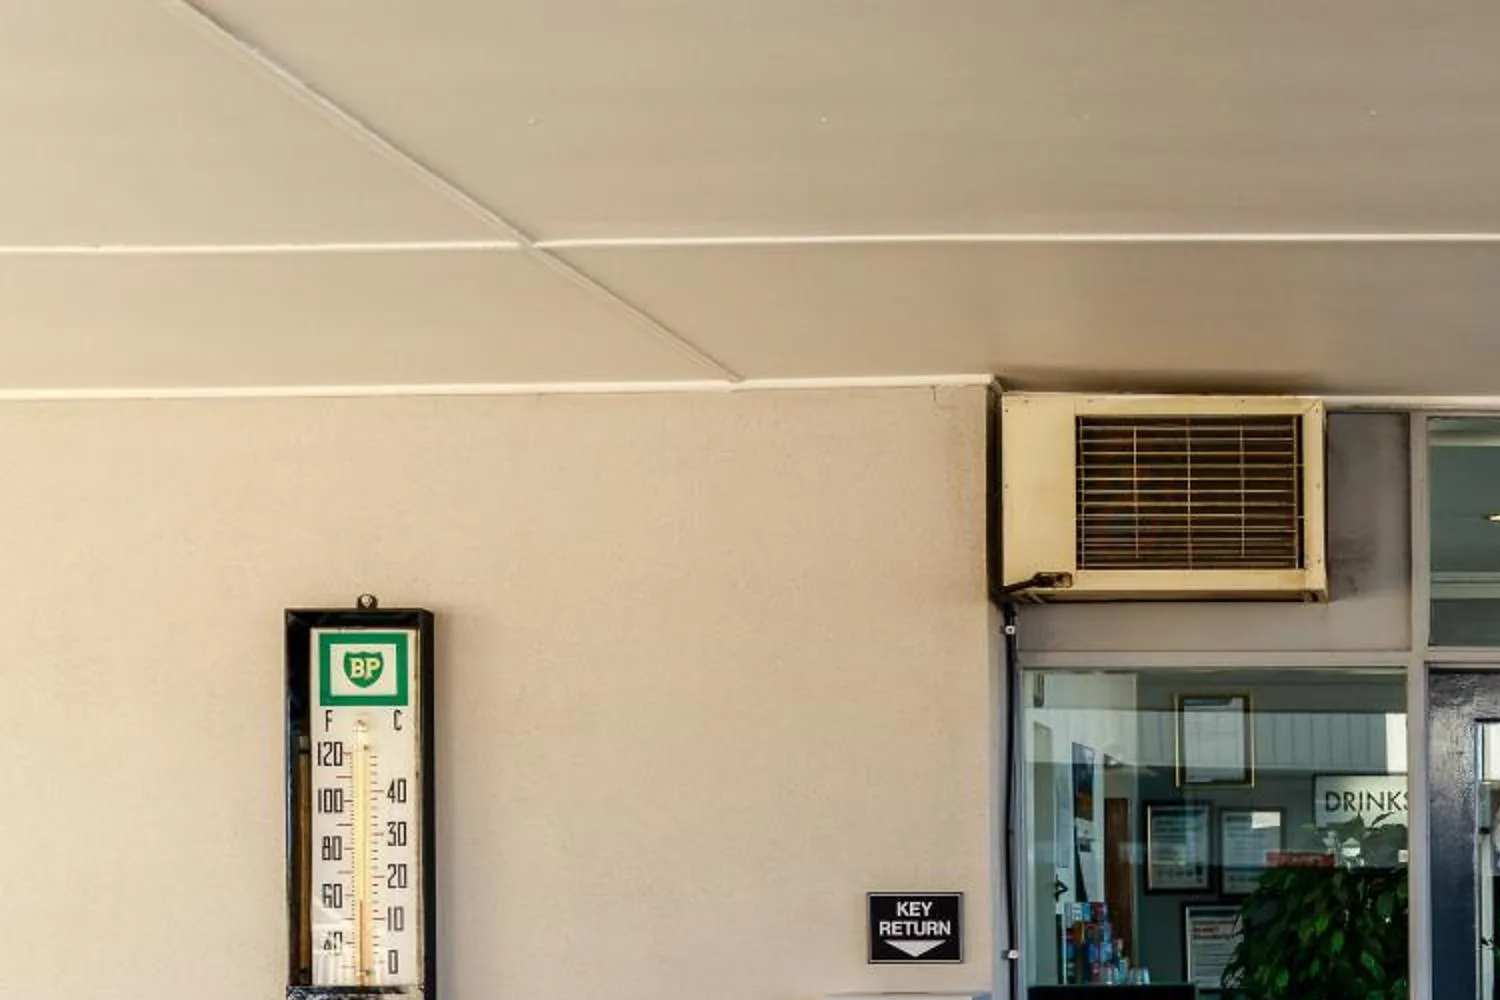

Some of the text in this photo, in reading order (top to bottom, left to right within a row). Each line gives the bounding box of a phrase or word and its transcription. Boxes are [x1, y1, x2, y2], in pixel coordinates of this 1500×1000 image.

[349, 657, 381, 679] BP
[325, 709, 402, 732] F C
[317, 741, 344, 767] 120
[317, 788, 344, 814] 100
[386, 778, 407, 804] 40
[386, 821, 407, 847] 30
[321, 835, 343, 861] 80
[387, 863, 408, 889] 20
[322, 883, 343, 909] 60
[896, 901, 933, 917] KEY
[387, 905, 405, 932] 10
[879, 920, 951, 936] RETURN
[387, 949, 399, 975] 0
